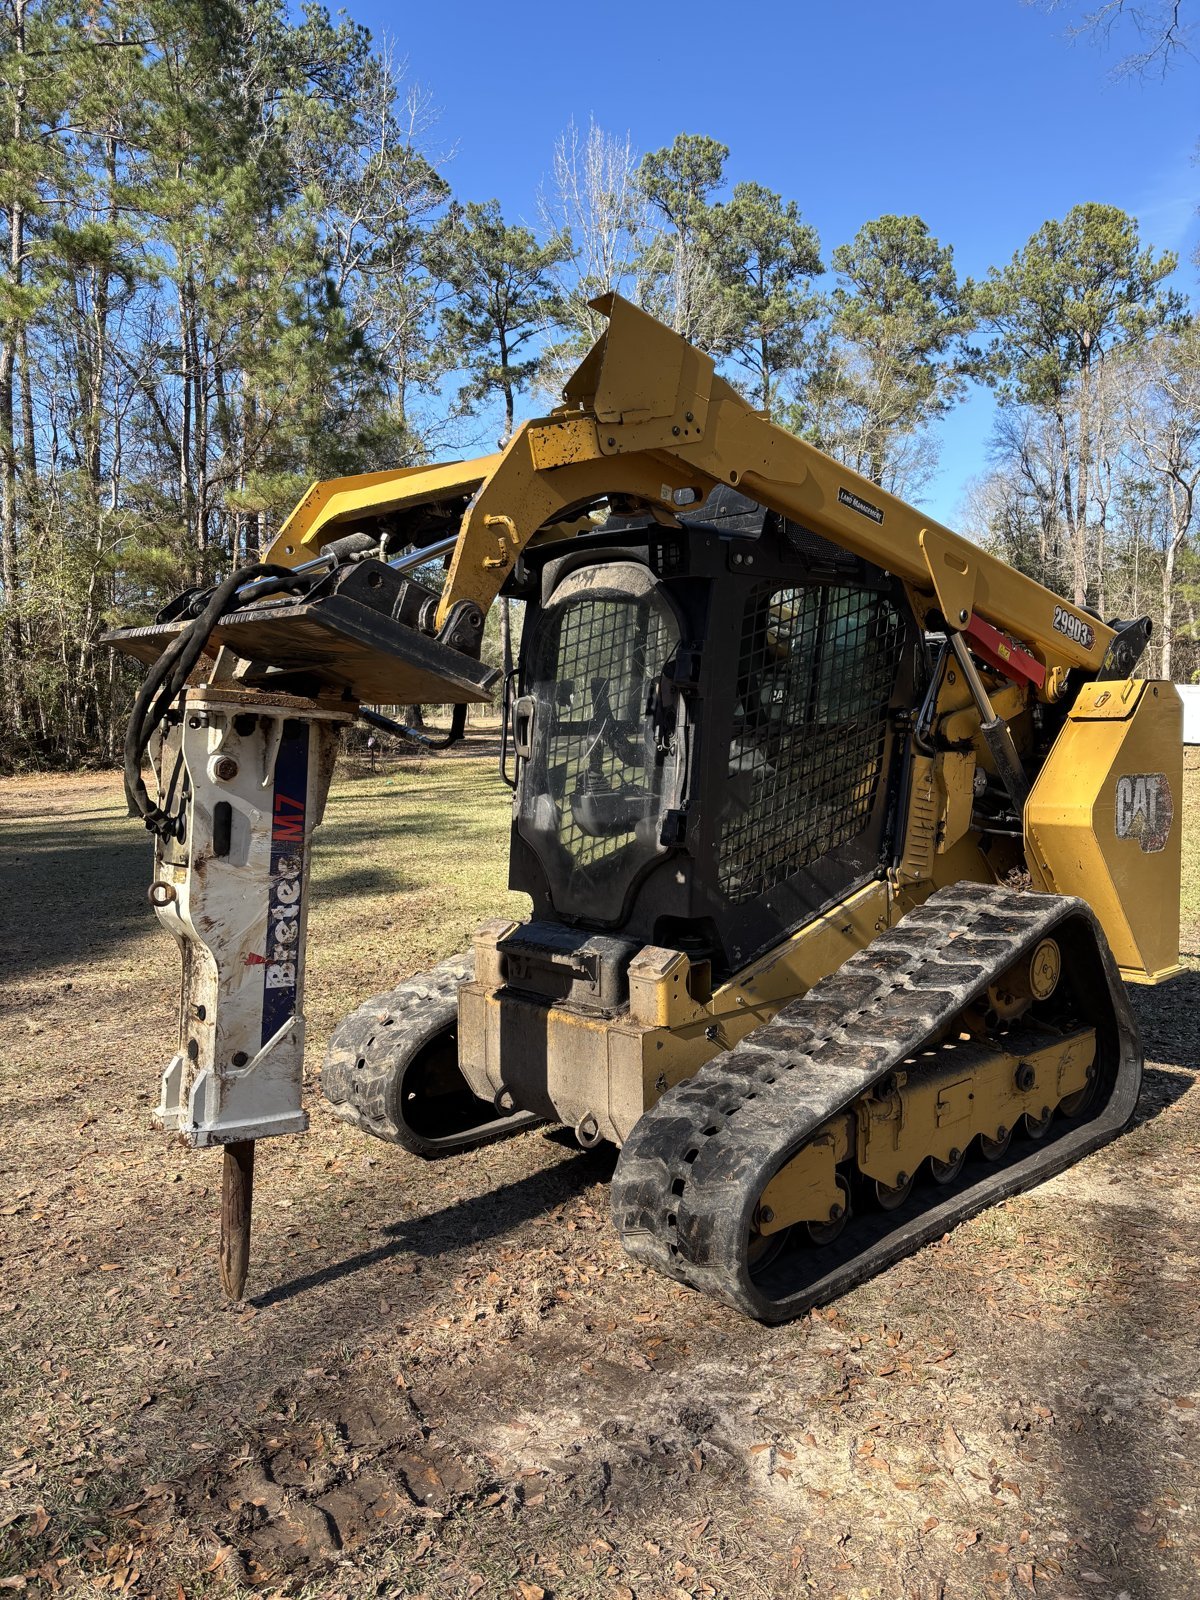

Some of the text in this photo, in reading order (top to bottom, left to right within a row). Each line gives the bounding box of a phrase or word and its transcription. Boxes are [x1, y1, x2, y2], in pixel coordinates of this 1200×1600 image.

[840, 492, 882, 522] LAND MANAGEMENT
[1053, 606, 1089, 647] 299D3
[272, 793, 305, 842] M7
[1117, 777, 1162, 837] CAT
